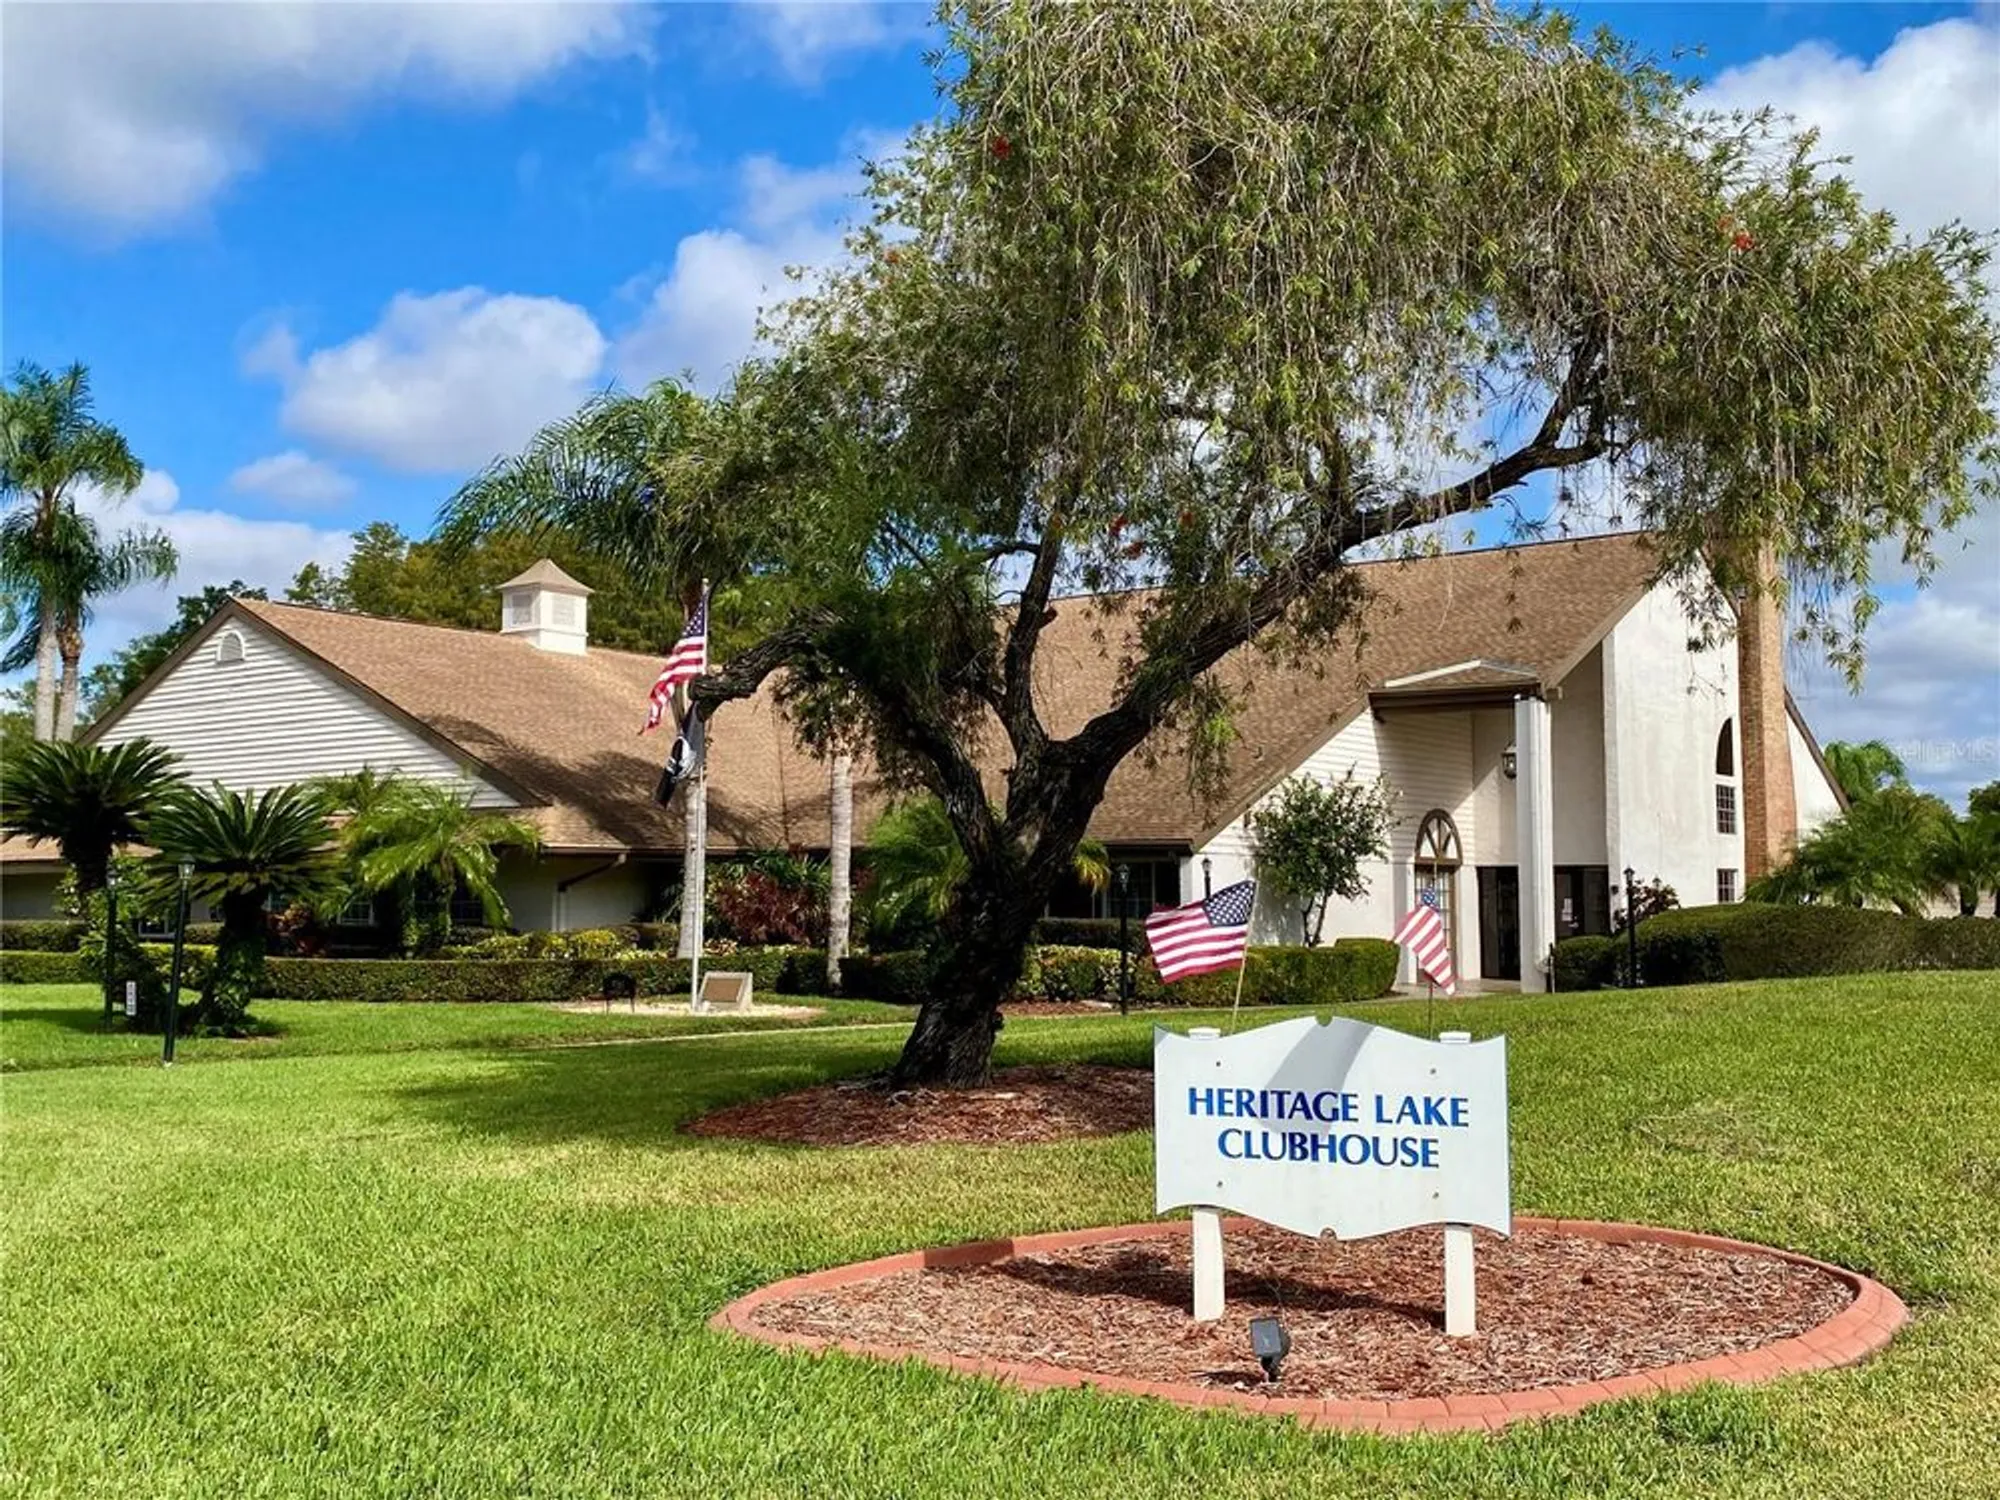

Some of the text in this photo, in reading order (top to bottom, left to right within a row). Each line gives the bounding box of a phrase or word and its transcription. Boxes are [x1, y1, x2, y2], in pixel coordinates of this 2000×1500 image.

[1188, 1087, 1469, 1127] HERITAGE LAKE
[1218, 1129, 1439, 1168] CLUBHOUSE
